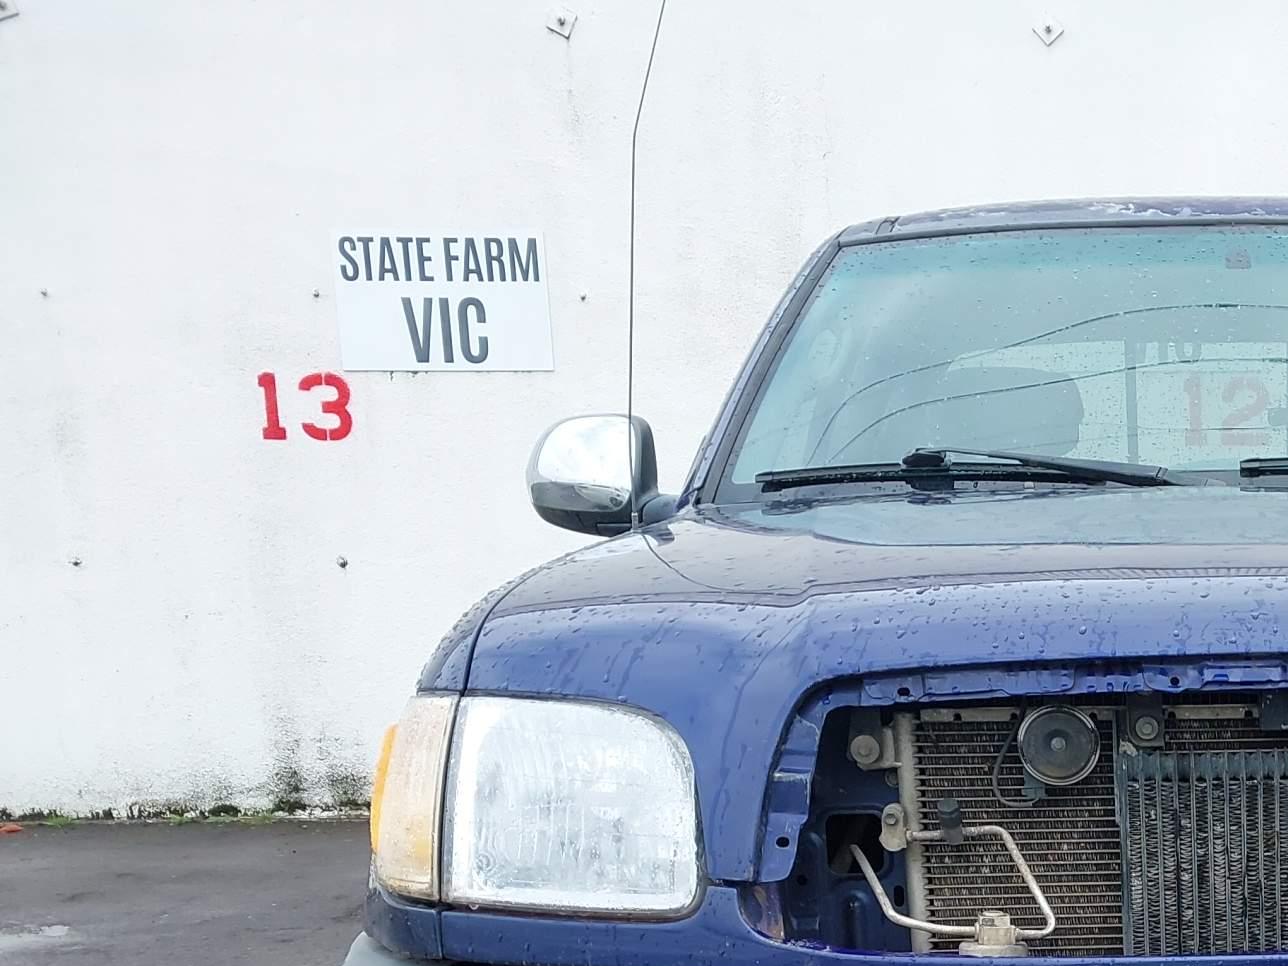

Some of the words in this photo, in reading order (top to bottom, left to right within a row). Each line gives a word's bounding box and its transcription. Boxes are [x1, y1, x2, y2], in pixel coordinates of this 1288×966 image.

[338, 236, 432, 283] STATE
[443, 236, 541, 283] FARM
[400, 296, 490, 364] VIC
[257, 371, 353, 442] 13
[1183, 373, 1272, 448] 12
